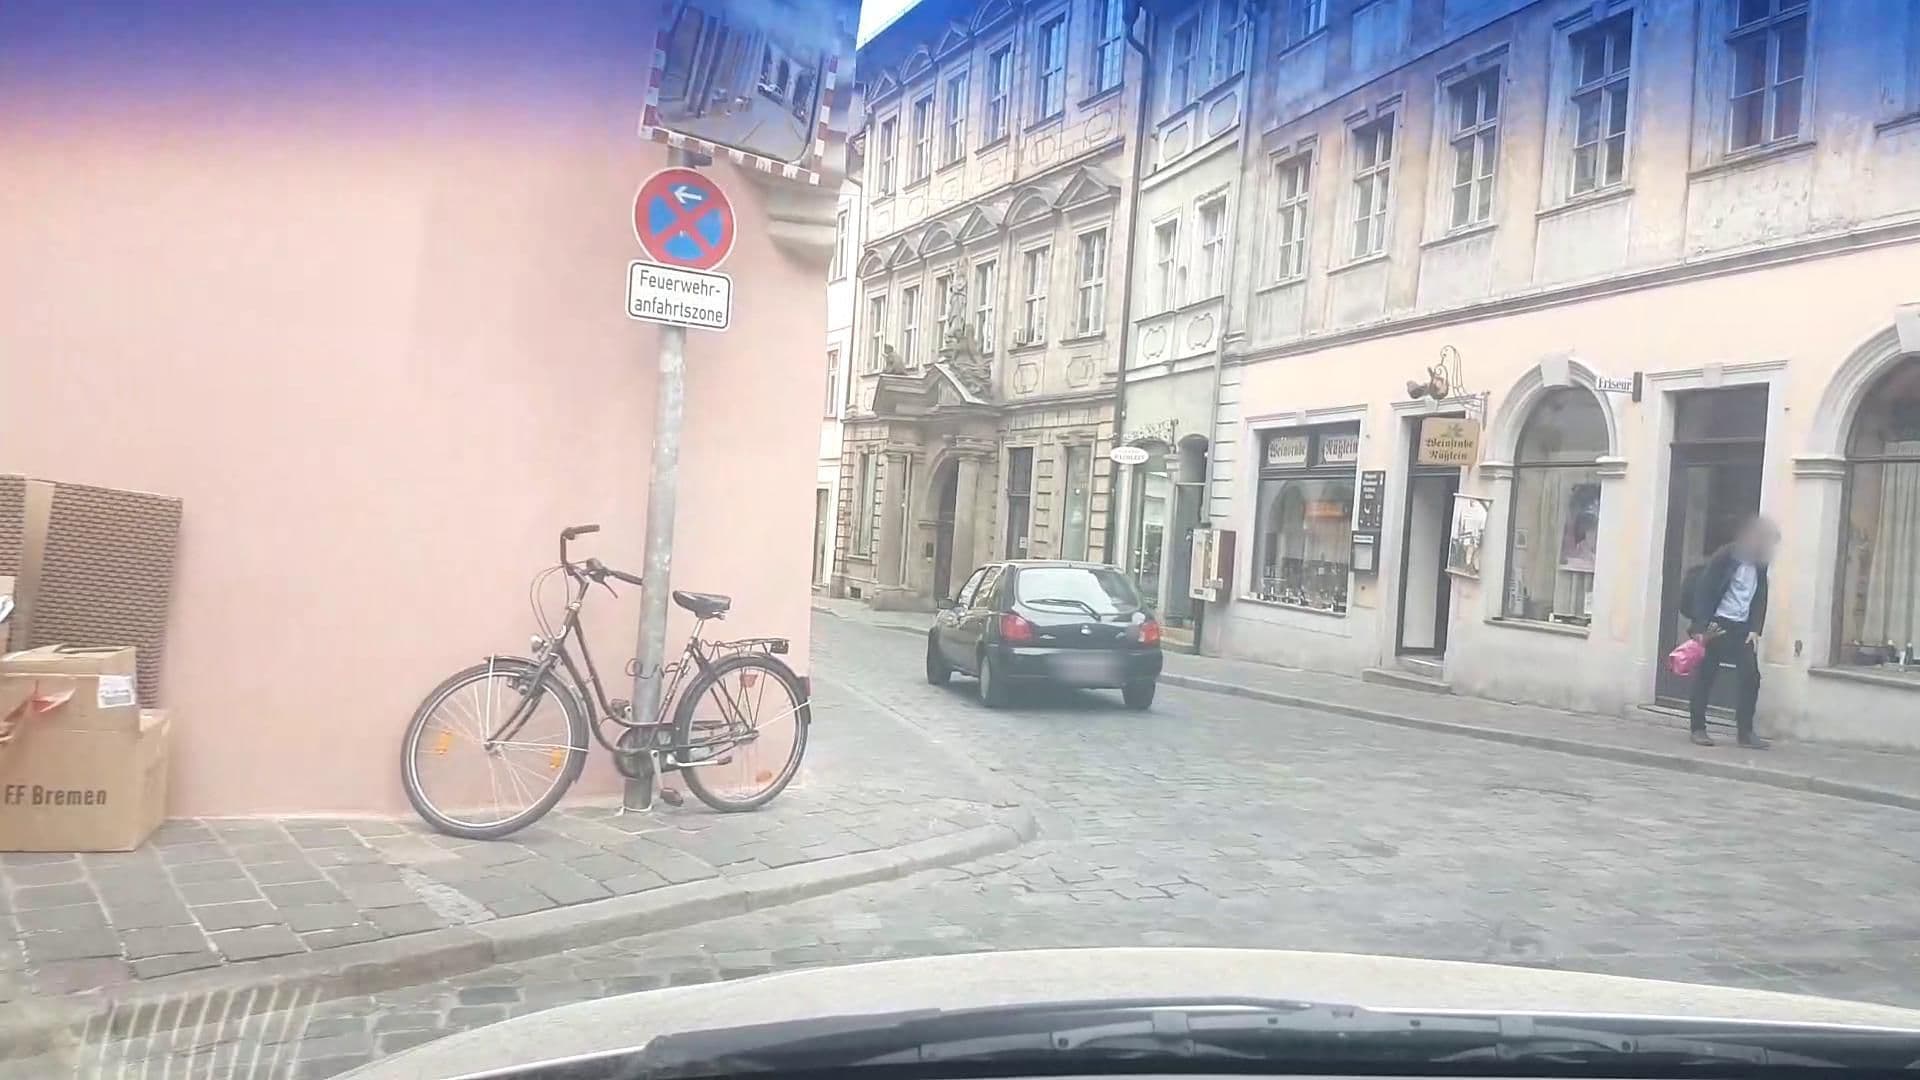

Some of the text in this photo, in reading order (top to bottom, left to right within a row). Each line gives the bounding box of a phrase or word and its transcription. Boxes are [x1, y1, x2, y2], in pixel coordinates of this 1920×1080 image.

[640, 270, 721, 297] Feuerwehr-
[634, 296, 723, 323] anfahrtszone
[1598, 377, 1632, 391] Friseur
[32, 784, 107, 805] Bremen
